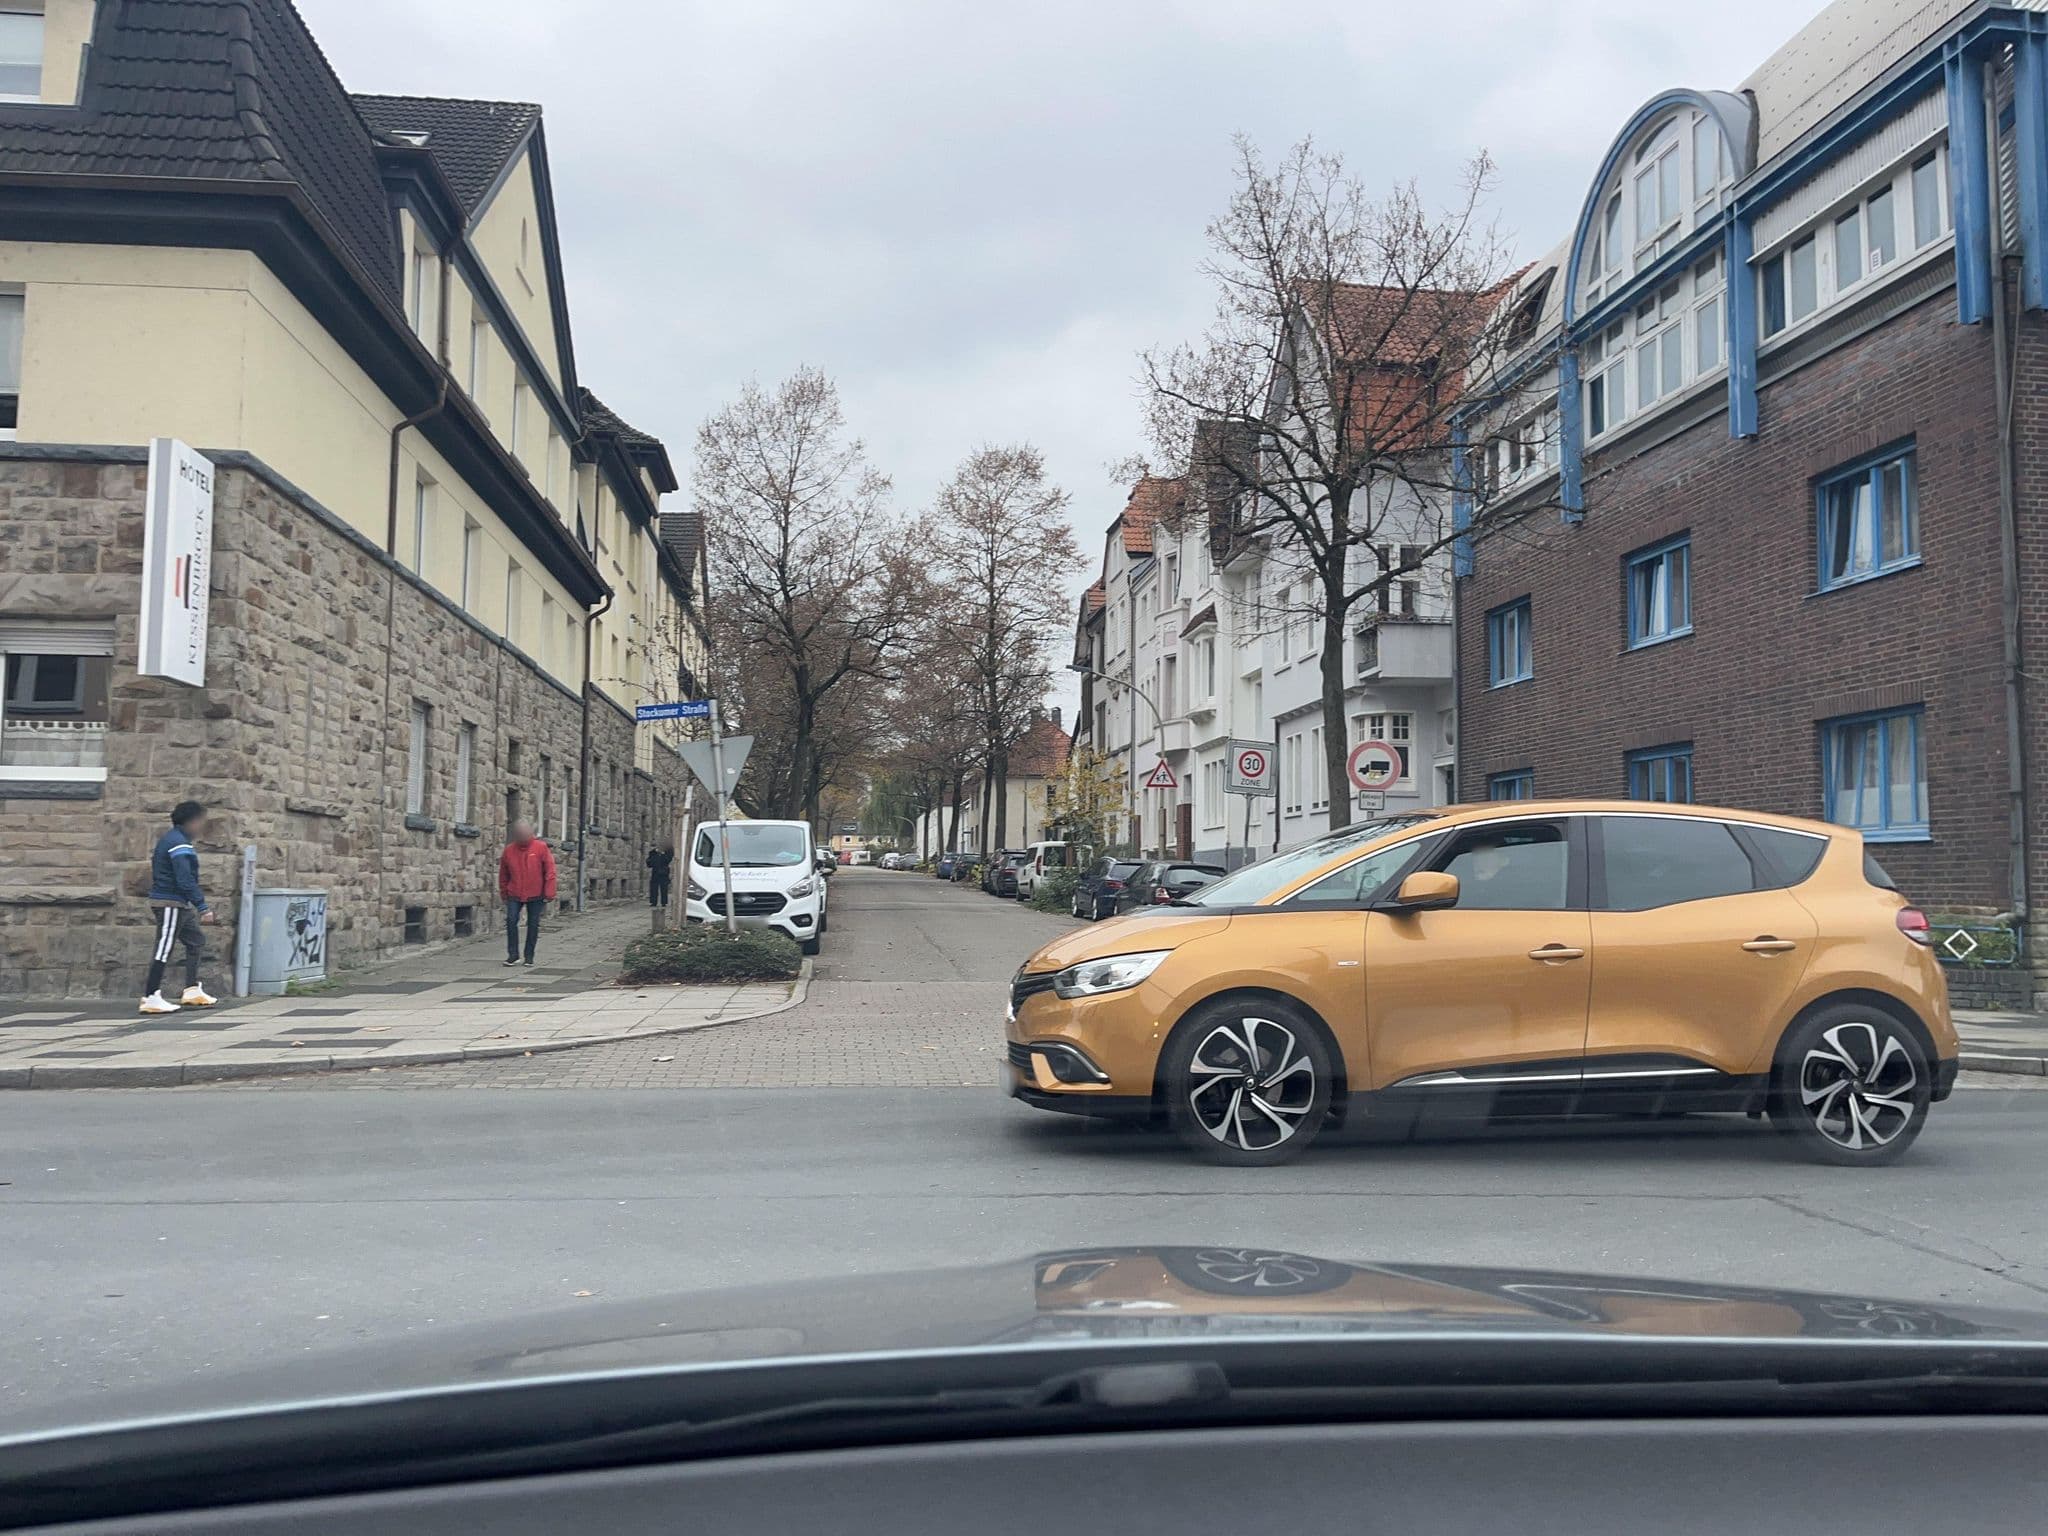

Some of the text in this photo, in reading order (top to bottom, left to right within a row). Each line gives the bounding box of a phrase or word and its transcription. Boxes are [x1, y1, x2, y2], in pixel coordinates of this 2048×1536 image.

[180, 460, 211, 494] HOTEL
[188, 508, 205, 665] KESSENBROCK
[637, 704, 708, 718] Stockumer Straße
[1244, 757, 1260, 771] 30
[1240, 778, 1261, 786] ZONE
